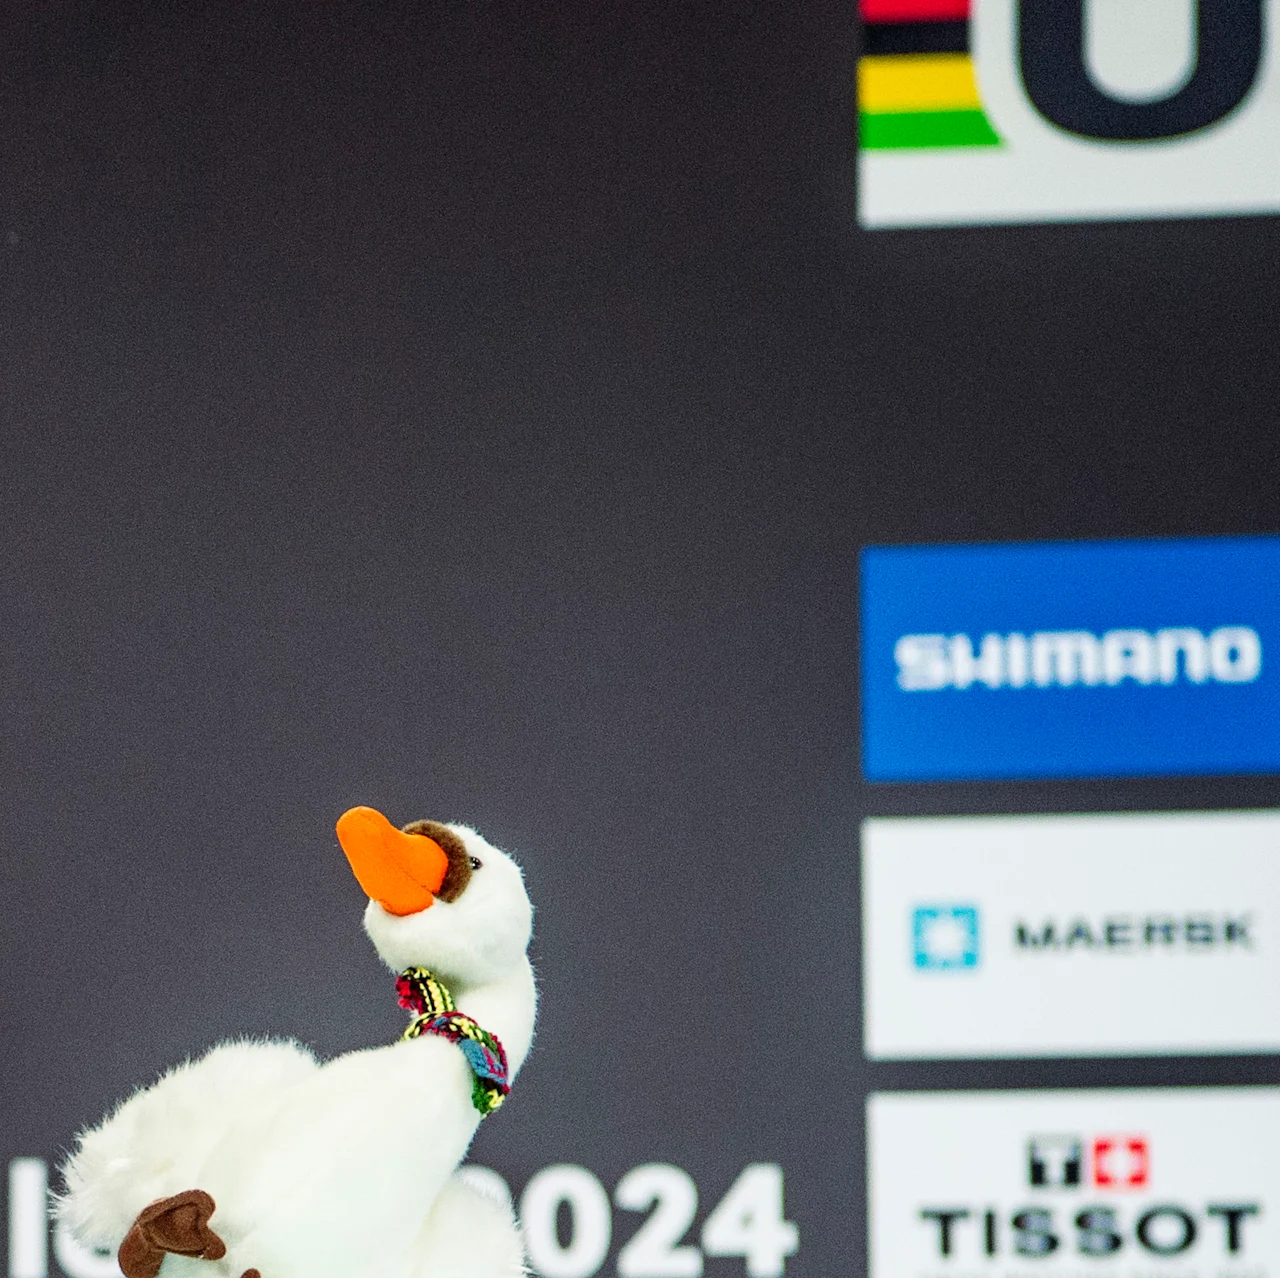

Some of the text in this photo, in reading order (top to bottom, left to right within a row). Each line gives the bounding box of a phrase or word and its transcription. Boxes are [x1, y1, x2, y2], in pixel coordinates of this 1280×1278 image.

[896, 626, 1262, 691] SHIMANO
[1014, 911, 1258, 954] MAERSK
[919, 1203, 1261, 1256] TISSOT
